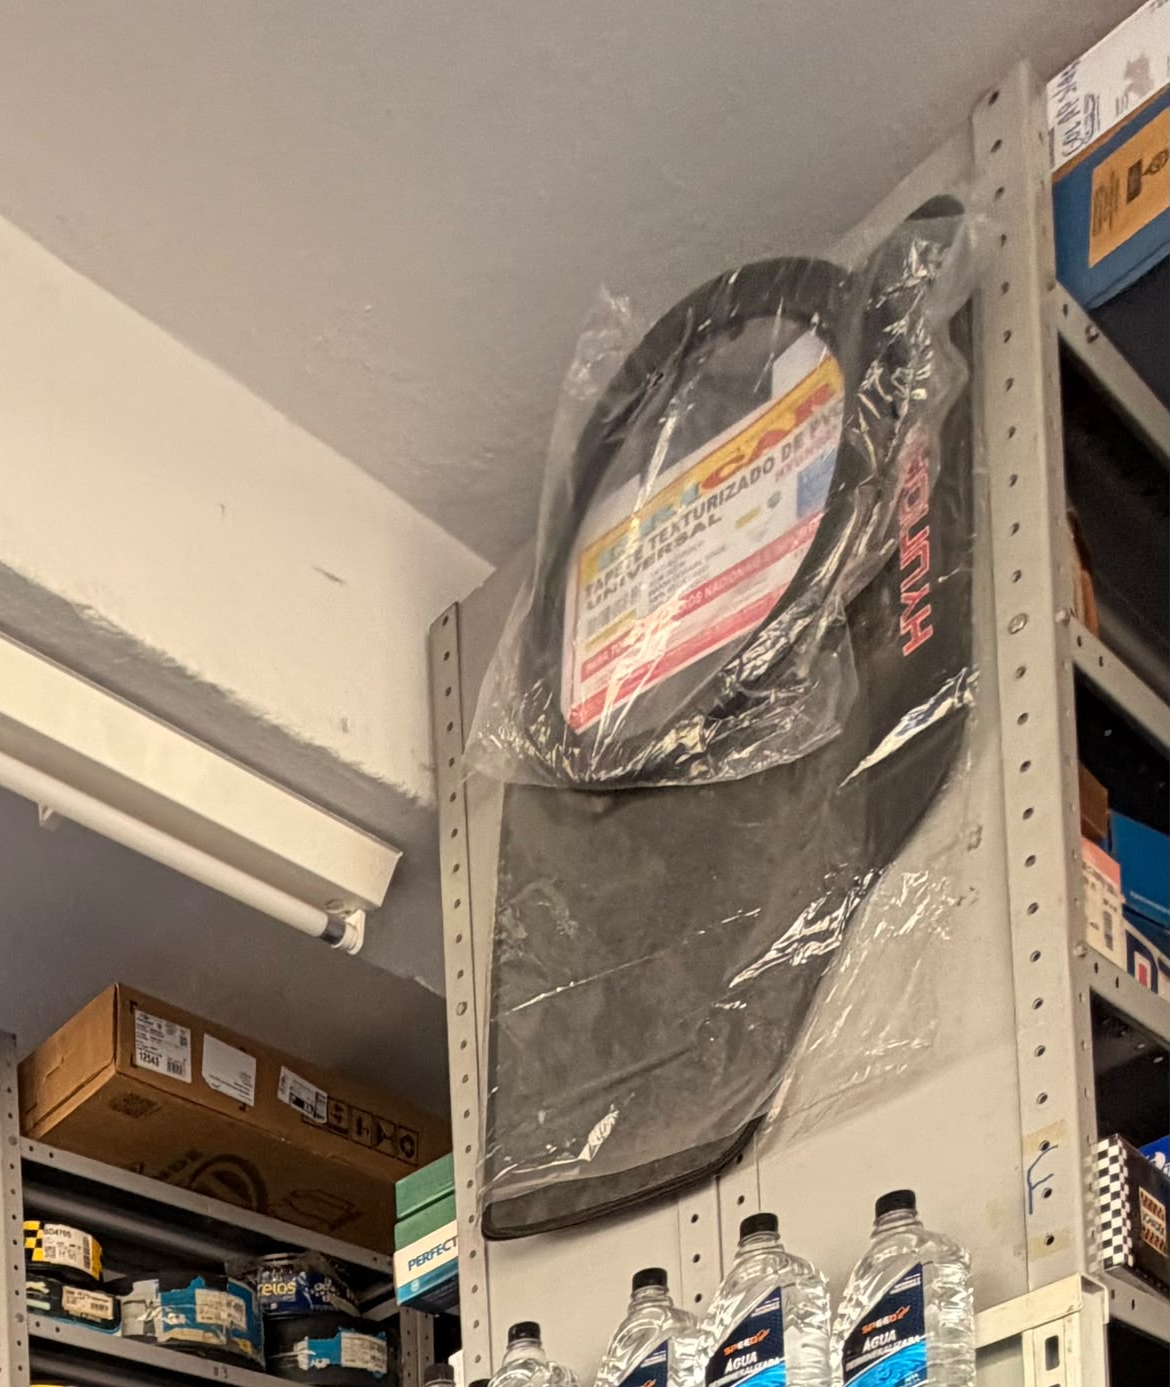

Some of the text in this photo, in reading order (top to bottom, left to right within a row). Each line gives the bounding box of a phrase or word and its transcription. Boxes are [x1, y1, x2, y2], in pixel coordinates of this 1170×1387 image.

[648, 456, 775, 550] TEXTURIZADO
[407, 1234, 458, 1272] PERFECT
[862, 1330, 897, 1353] ÁGUA
[725, 1351, 758, 1374] ÁGUA
